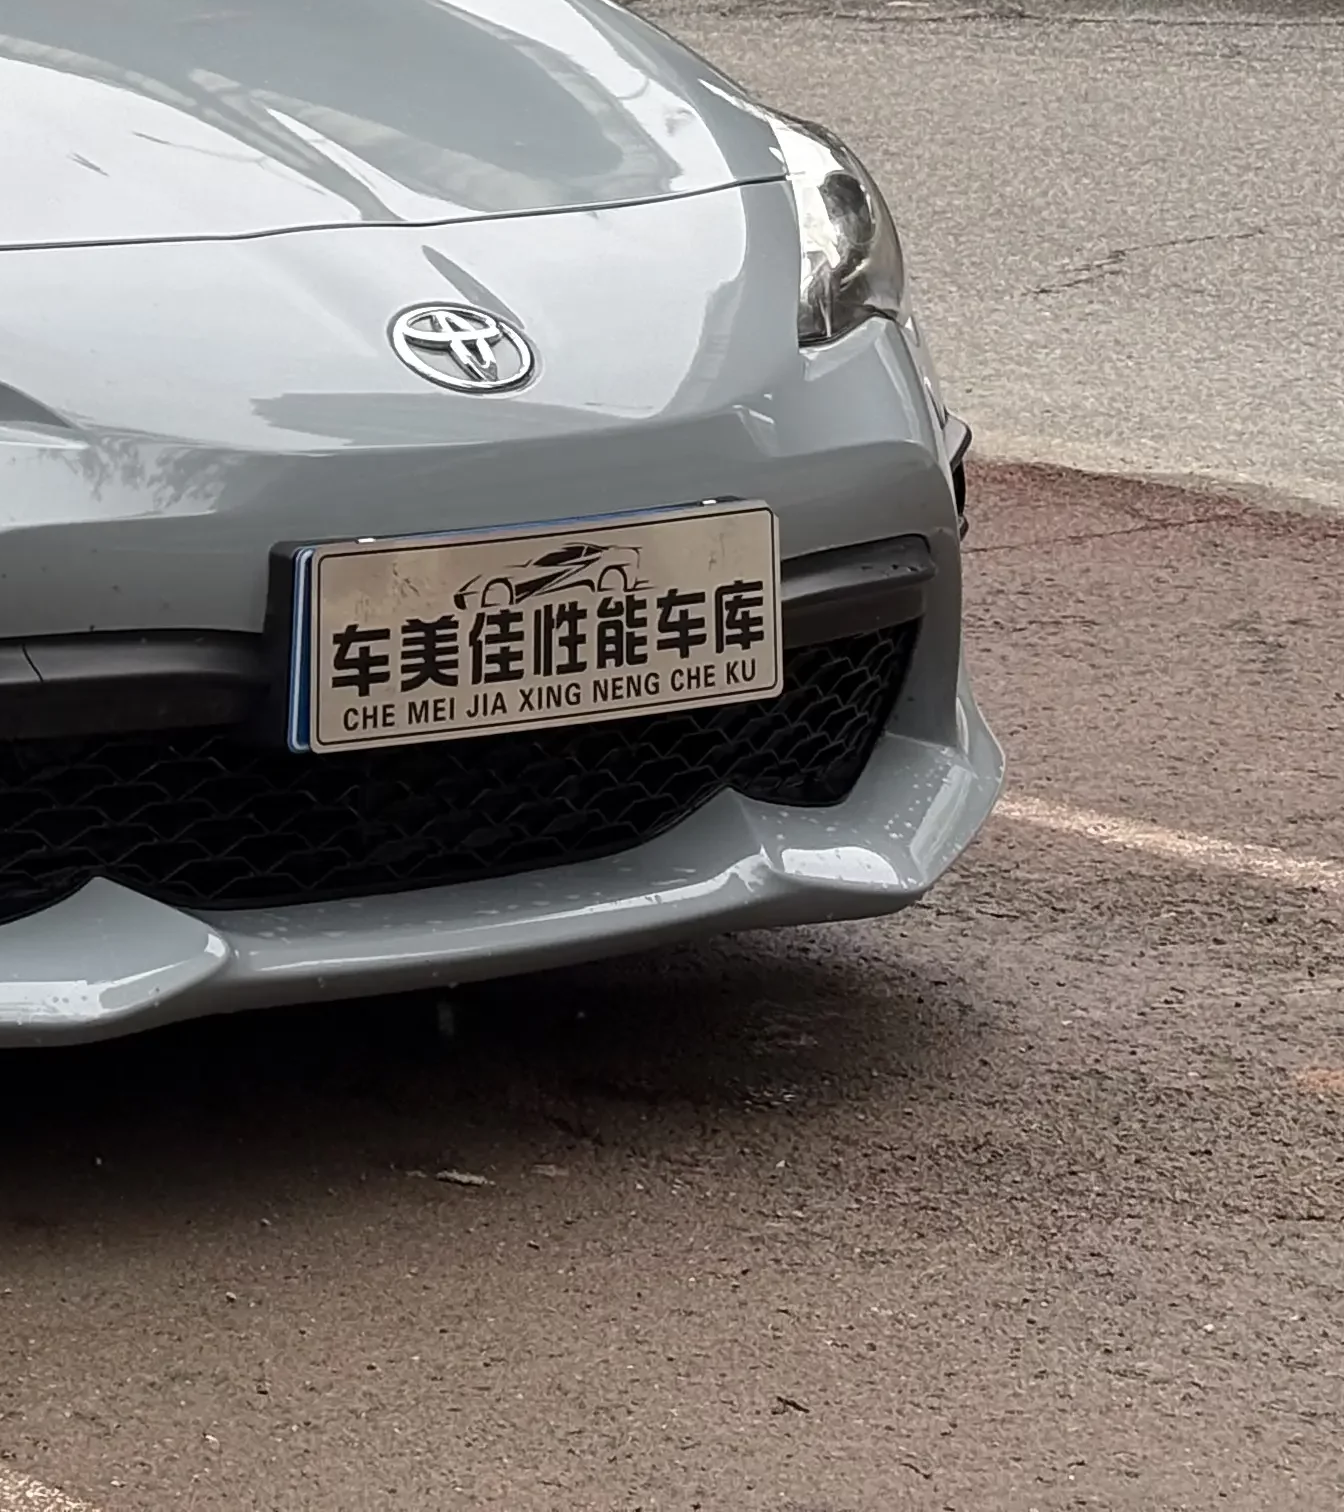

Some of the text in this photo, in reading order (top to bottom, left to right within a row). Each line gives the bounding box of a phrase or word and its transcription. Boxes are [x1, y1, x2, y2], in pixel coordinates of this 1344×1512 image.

[331, 579, 765, 698] 车美佳性能车库
[343, 658, 756, 732] CHE MEI JIA XING NENG CHE KU
